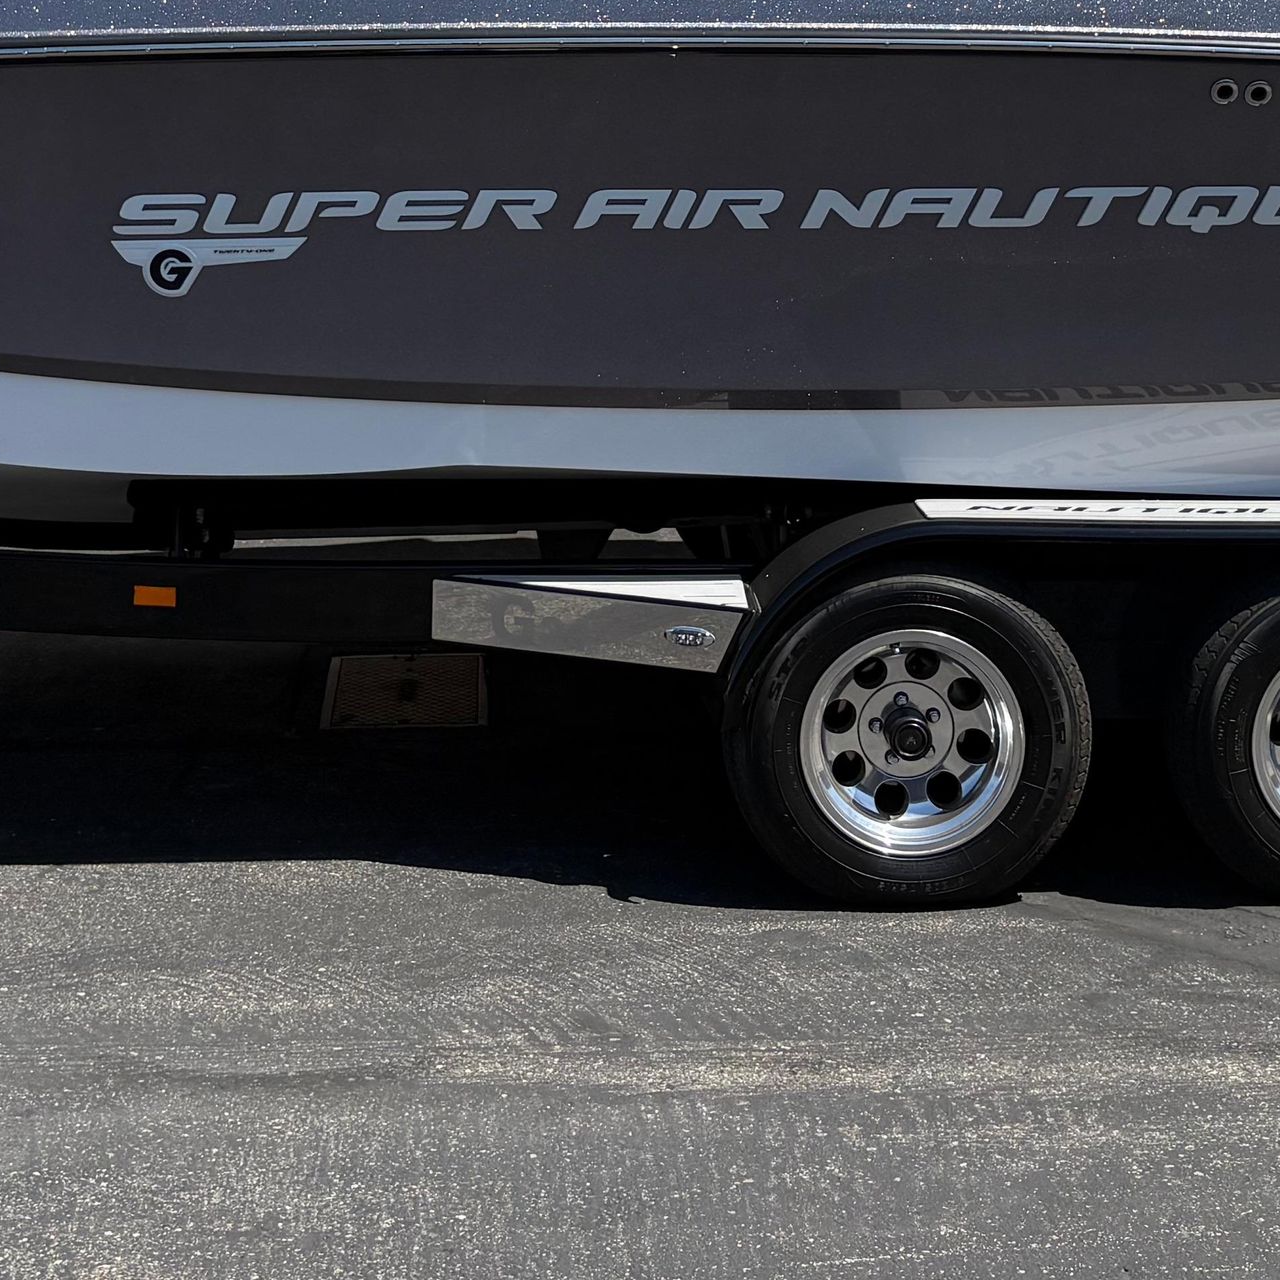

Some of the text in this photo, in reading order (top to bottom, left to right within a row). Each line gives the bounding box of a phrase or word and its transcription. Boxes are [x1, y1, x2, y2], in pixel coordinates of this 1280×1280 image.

[112, 189, 558, 235] SUPER
[573, 188, 785, 230] AIR
[149, 249, 194, 291] G
